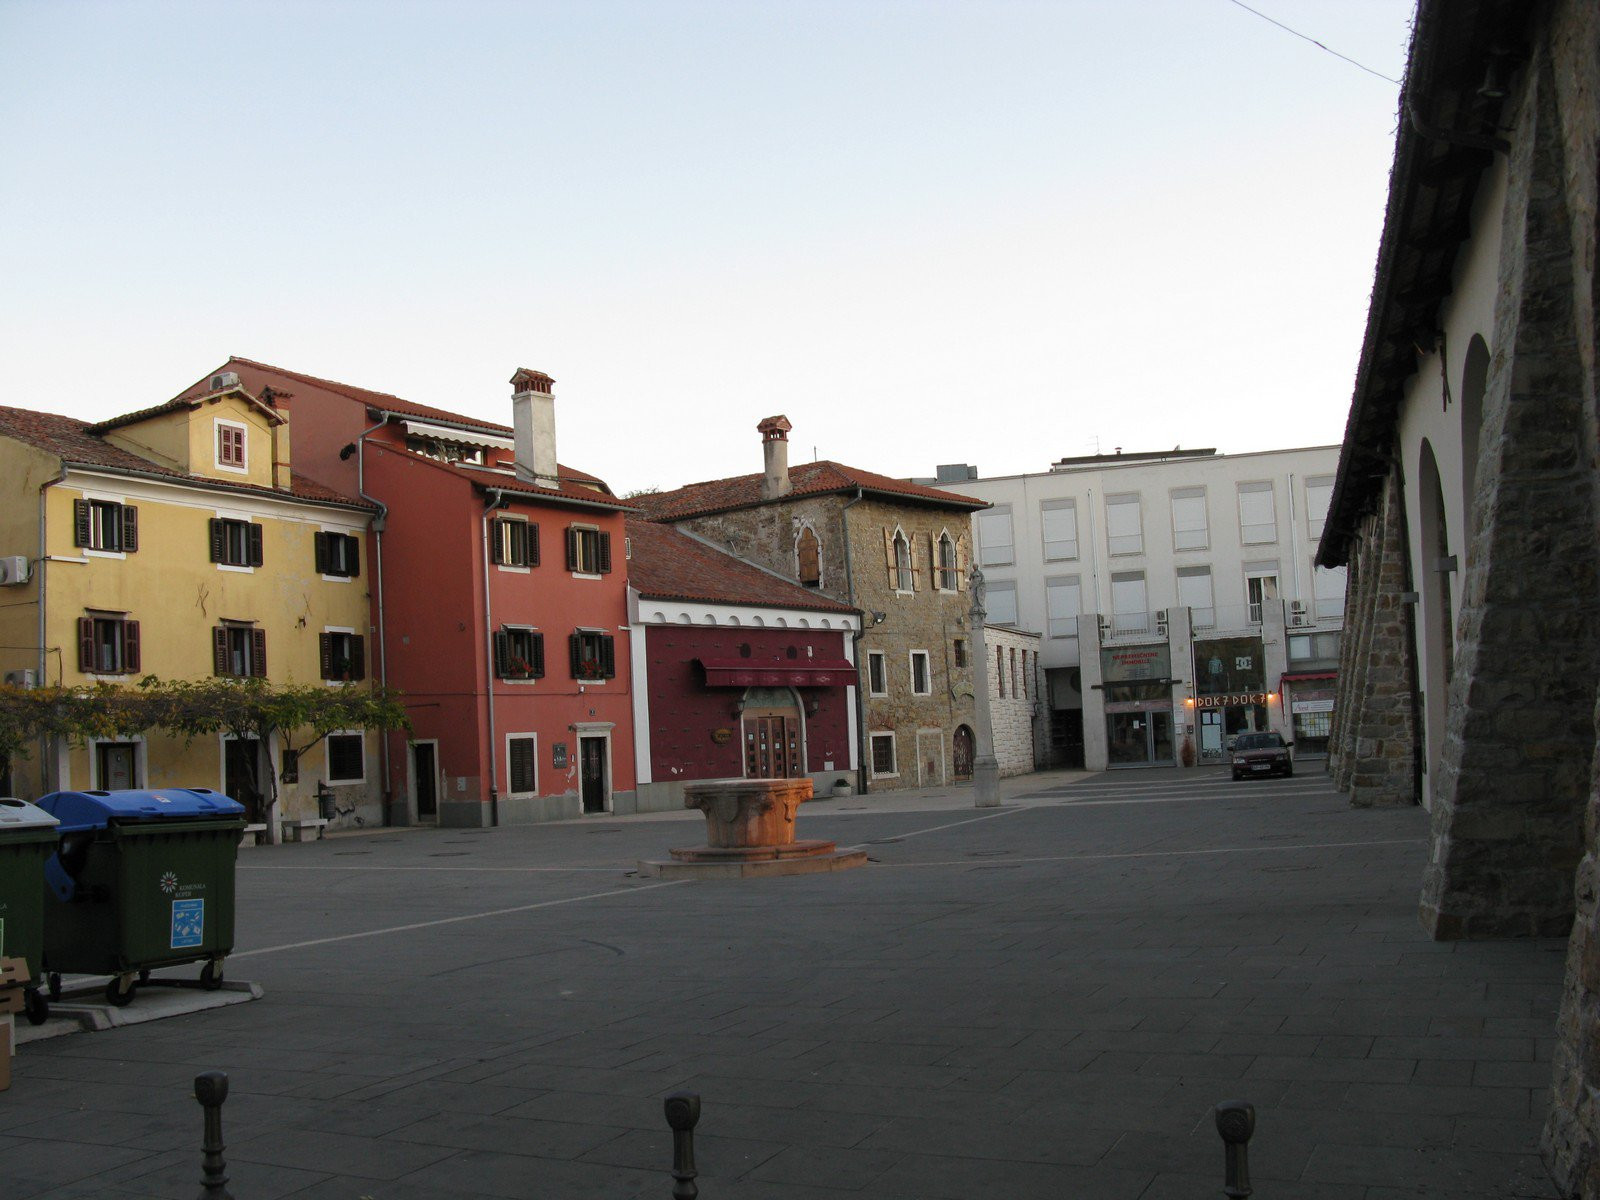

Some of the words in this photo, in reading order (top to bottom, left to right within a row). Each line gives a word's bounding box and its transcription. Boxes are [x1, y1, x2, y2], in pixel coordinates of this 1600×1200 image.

[1198, 697, 1220, 707] DOK
[1223, 696, 1229, 706] 7
[1232, 694, 1256, 704] DOK
[1259, 693, 1266, 703] 7
